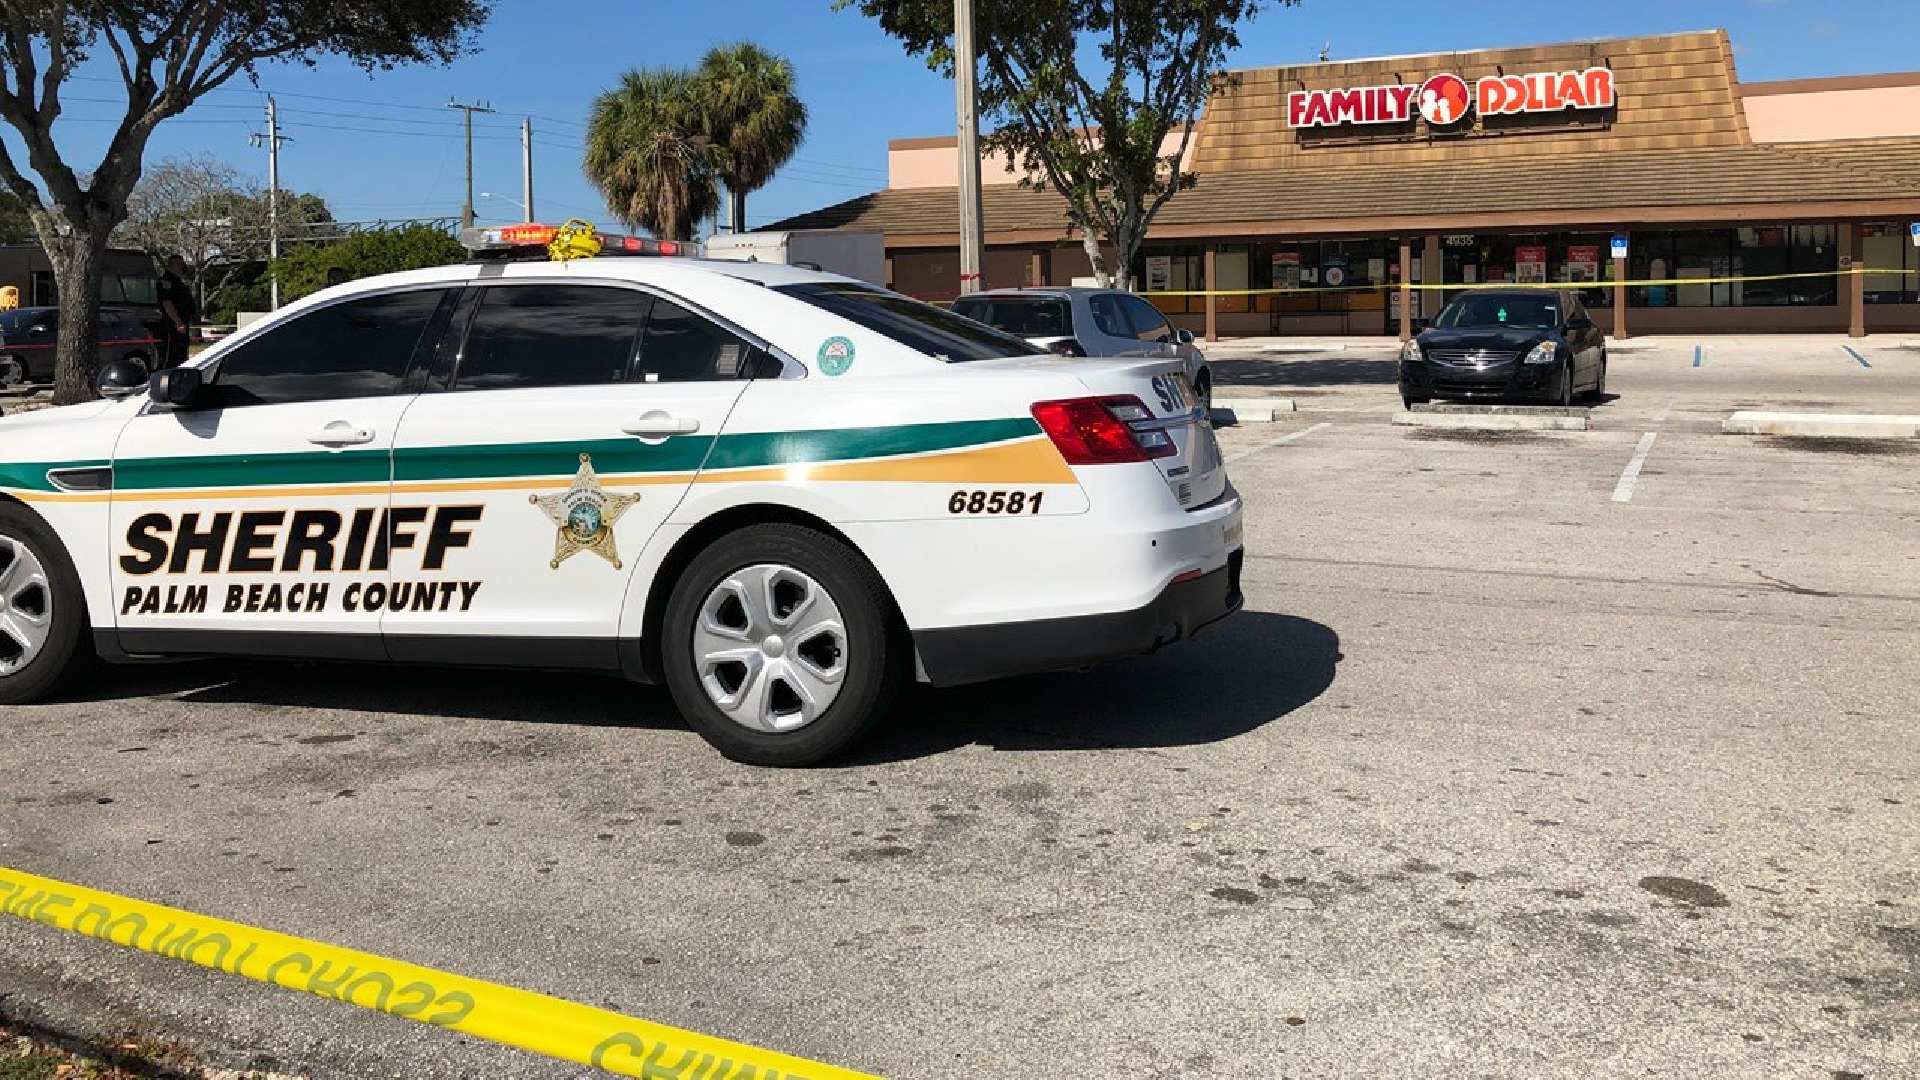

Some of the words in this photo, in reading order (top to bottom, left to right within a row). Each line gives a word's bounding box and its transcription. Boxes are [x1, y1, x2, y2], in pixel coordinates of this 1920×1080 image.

[1288, 85, 1416, 127] FAMILY
[1476, 67, 1614, 114] DOLLAR
[1446, 234, 1474, 246] 4935
[948, 490, 1044, 515] 68581
[119, 503, 486, 576] SHERIFF
[120, 584, 208, 616] PALM
[222, 582, 330, 613] BEACH
[342, 580, 482, 613] COUNTY
